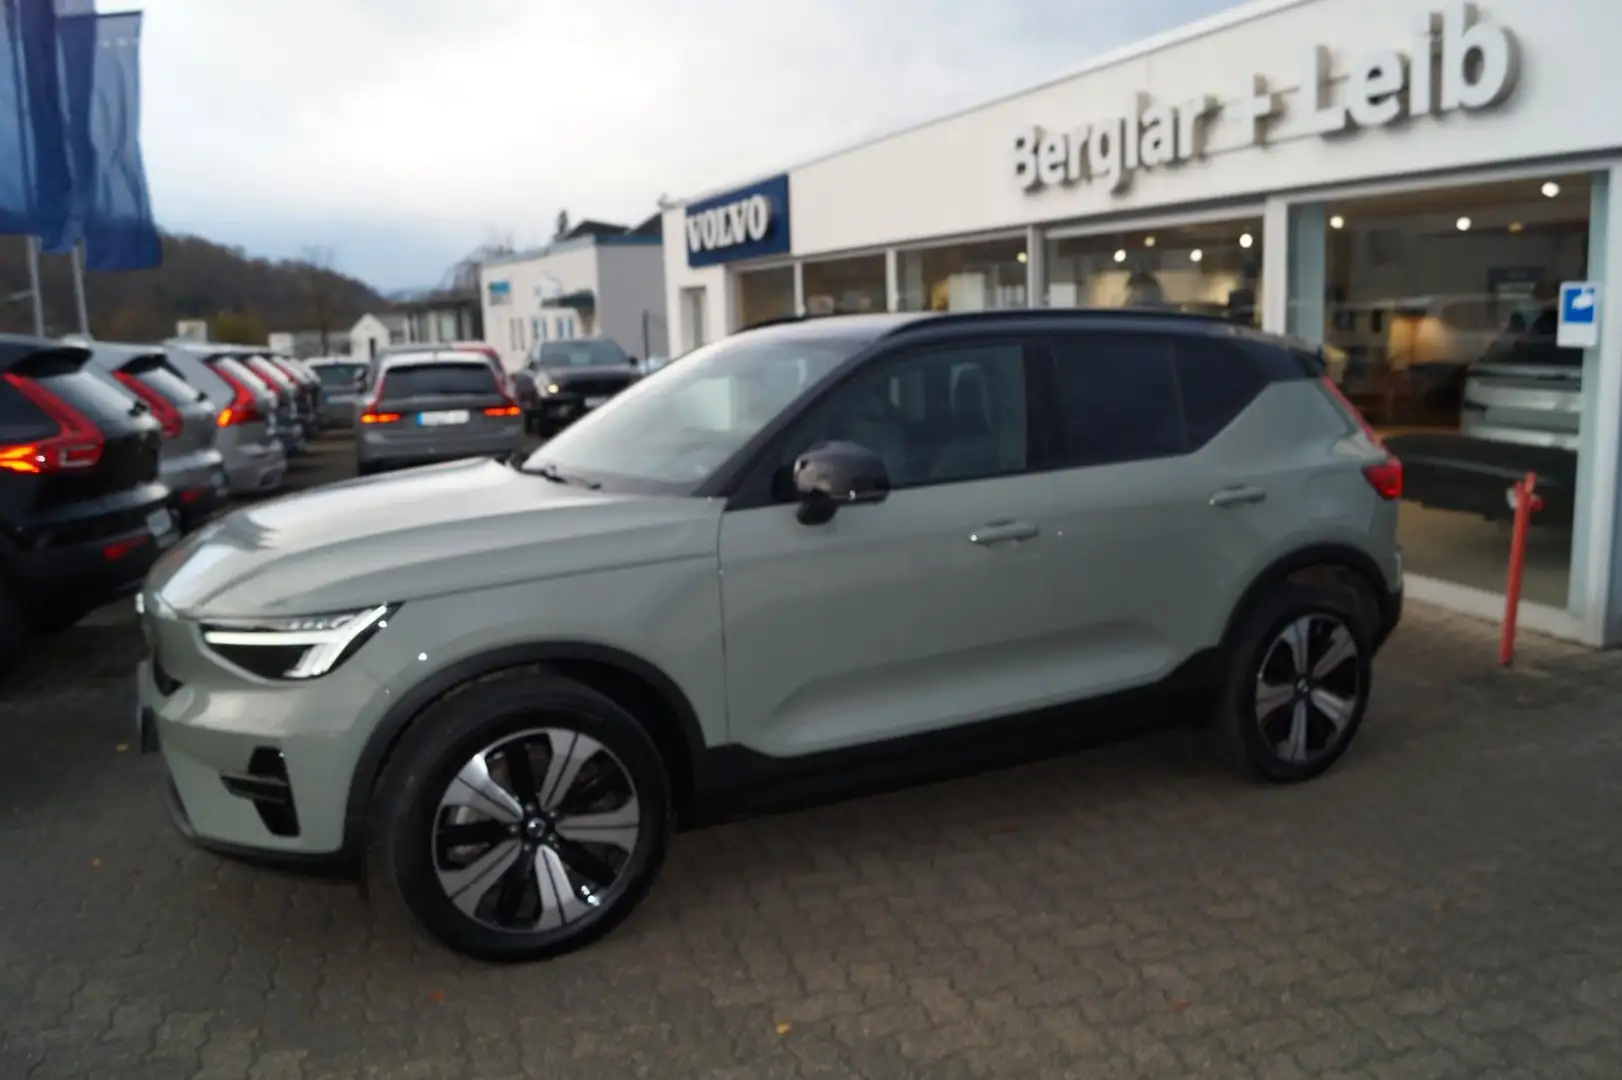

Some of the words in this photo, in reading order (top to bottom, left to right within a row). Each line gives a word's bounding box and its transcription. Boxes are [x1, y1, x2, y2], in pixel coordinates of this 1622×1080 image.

[1010, 90, 1220, 194] Berglar
[1223, 73, 1279, 148] +
[1300, 1, 1514, 131] Leib
[687, 194, 769, 253] VOLVO
